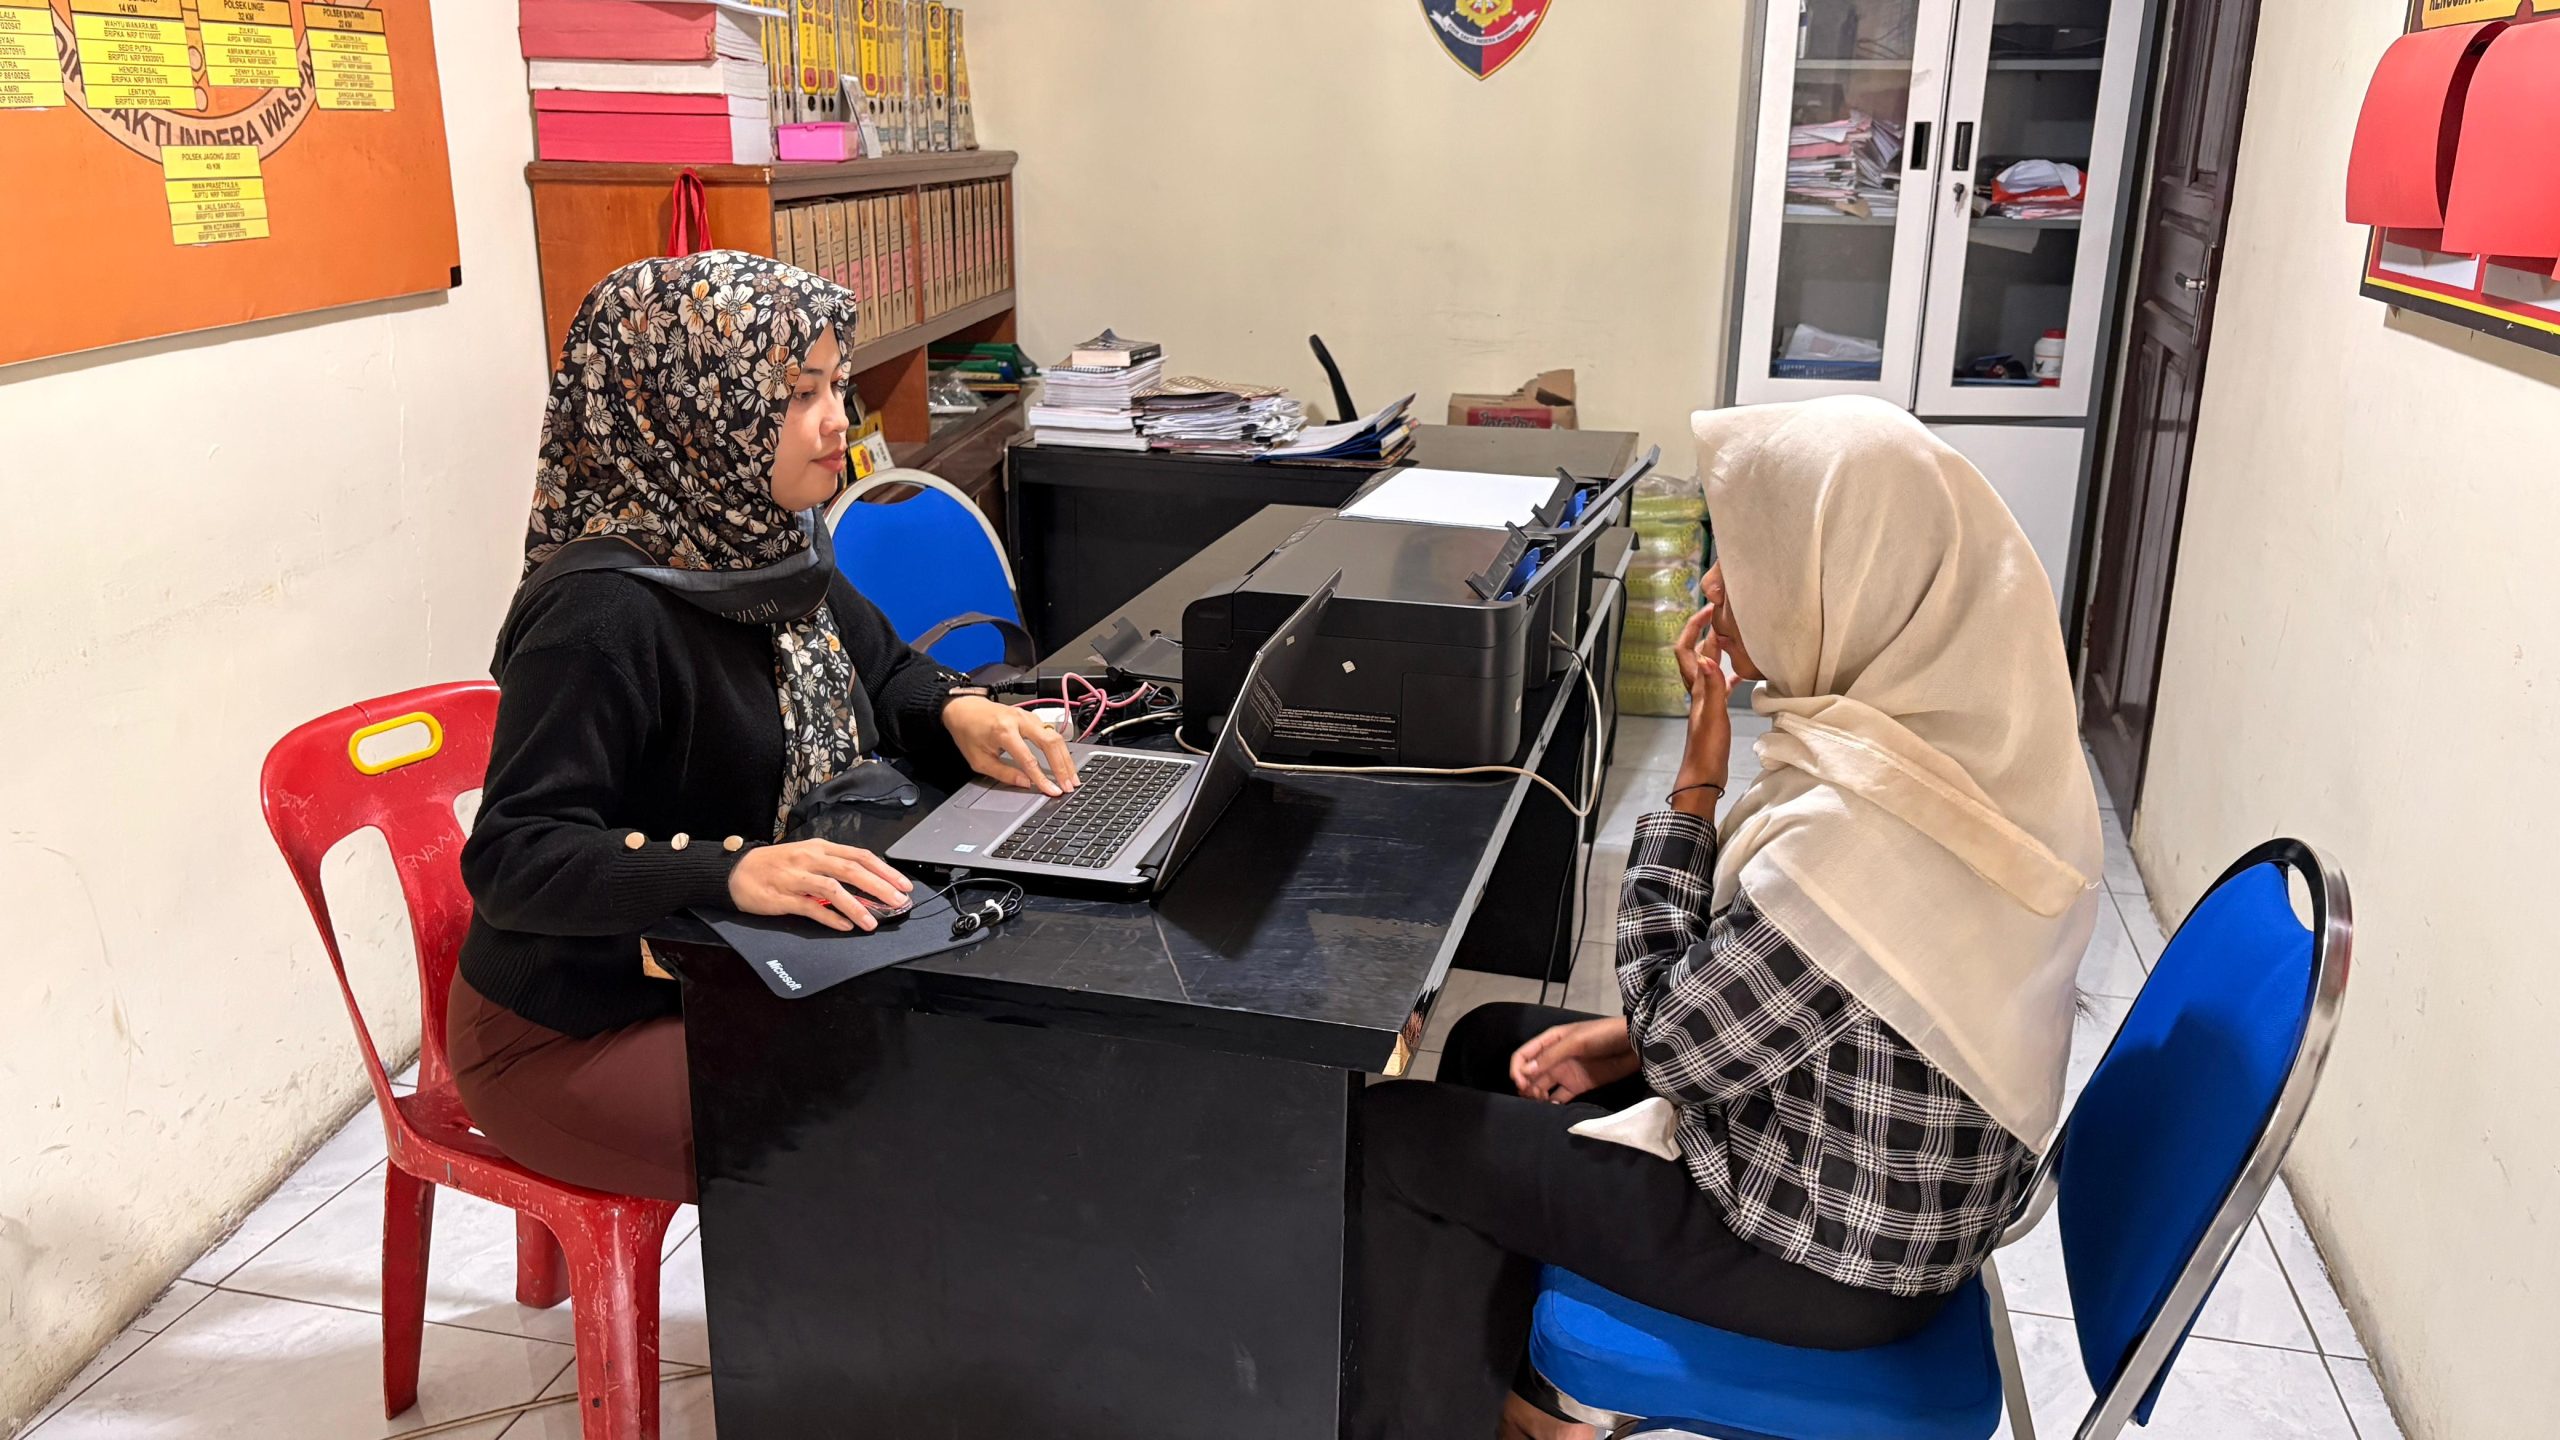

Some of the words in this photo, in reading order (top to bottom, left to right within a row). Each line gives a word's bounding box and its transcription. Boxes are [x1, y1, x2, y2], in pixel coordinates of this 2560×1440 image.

[118, 4, 126, 12] 14
[127, 4, 138, 13] KM
[224, 0, 247, 10] POLSEK
[248, 2, 265, 11] LINGE
[246, 13, 254, 21] KM
[322, 8, 343, 18] POLSEK
[104, 20, 125, 28] WAHYU
[130, 54, 141, 62] NRP
[100, 106, 172, 147] AKTI
[258, 48, 313, 138] WASPA
[766, 959, 802, 991] Microsoft
